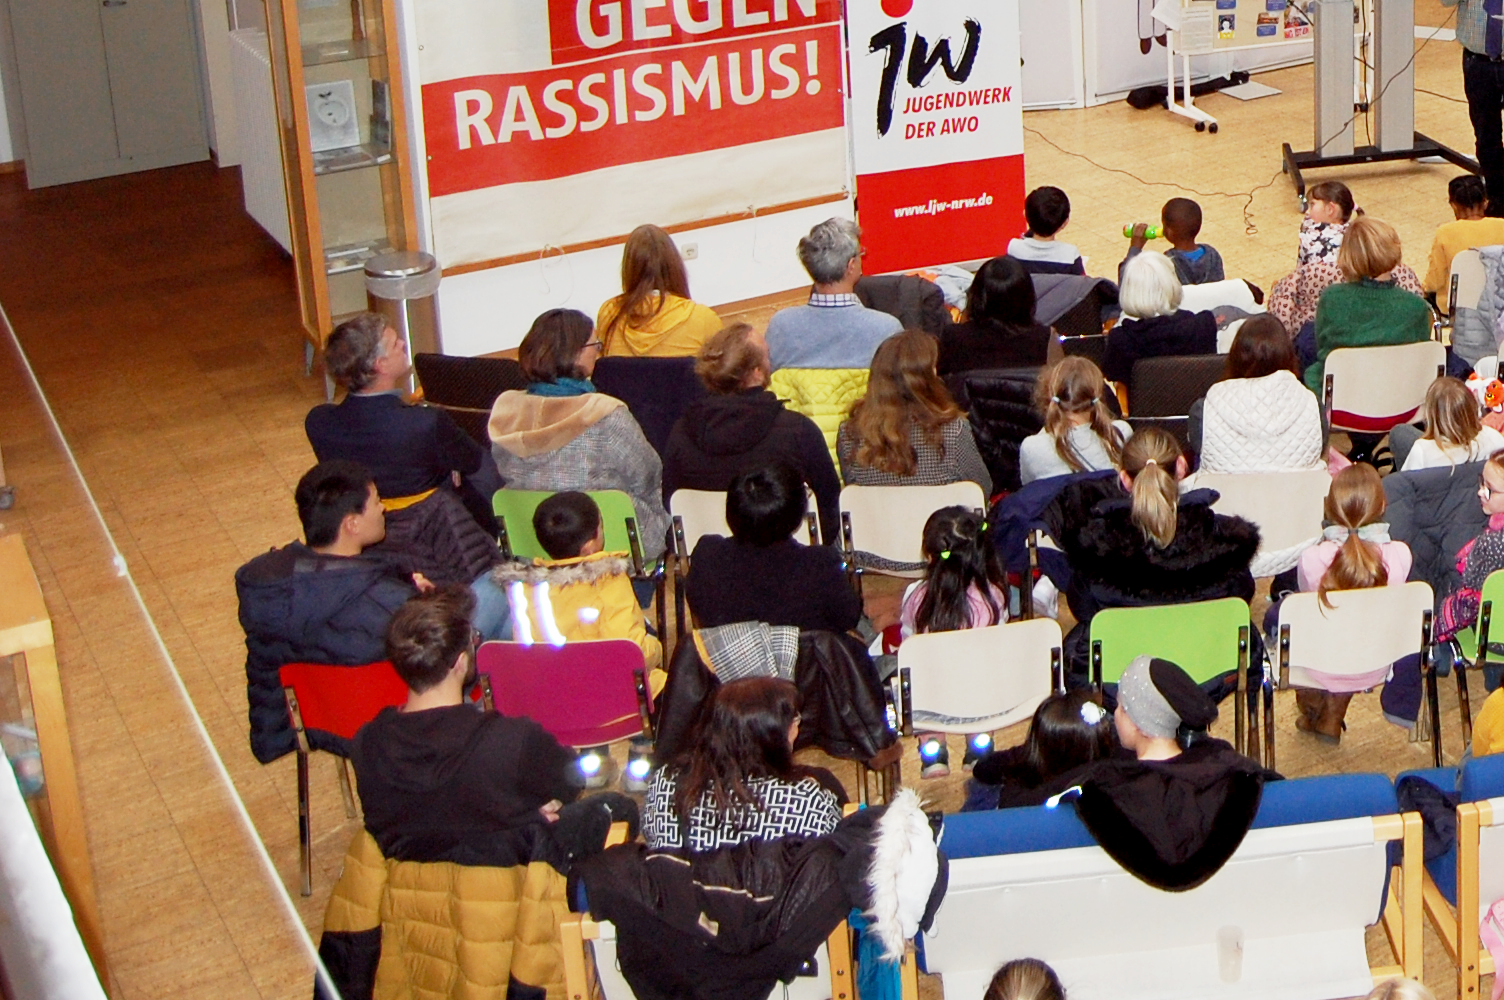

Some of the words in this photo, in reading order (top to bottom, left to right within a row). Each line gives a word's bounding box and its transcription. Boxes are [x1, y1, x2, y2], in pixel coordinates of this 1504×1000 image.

[454, 39, 822, 150] RASSISMUS!
[902, 86, 1013, 114] JUGENDWERK
[904, 120, 936, 140] DER
[940, 115, 979, 135] AWO
